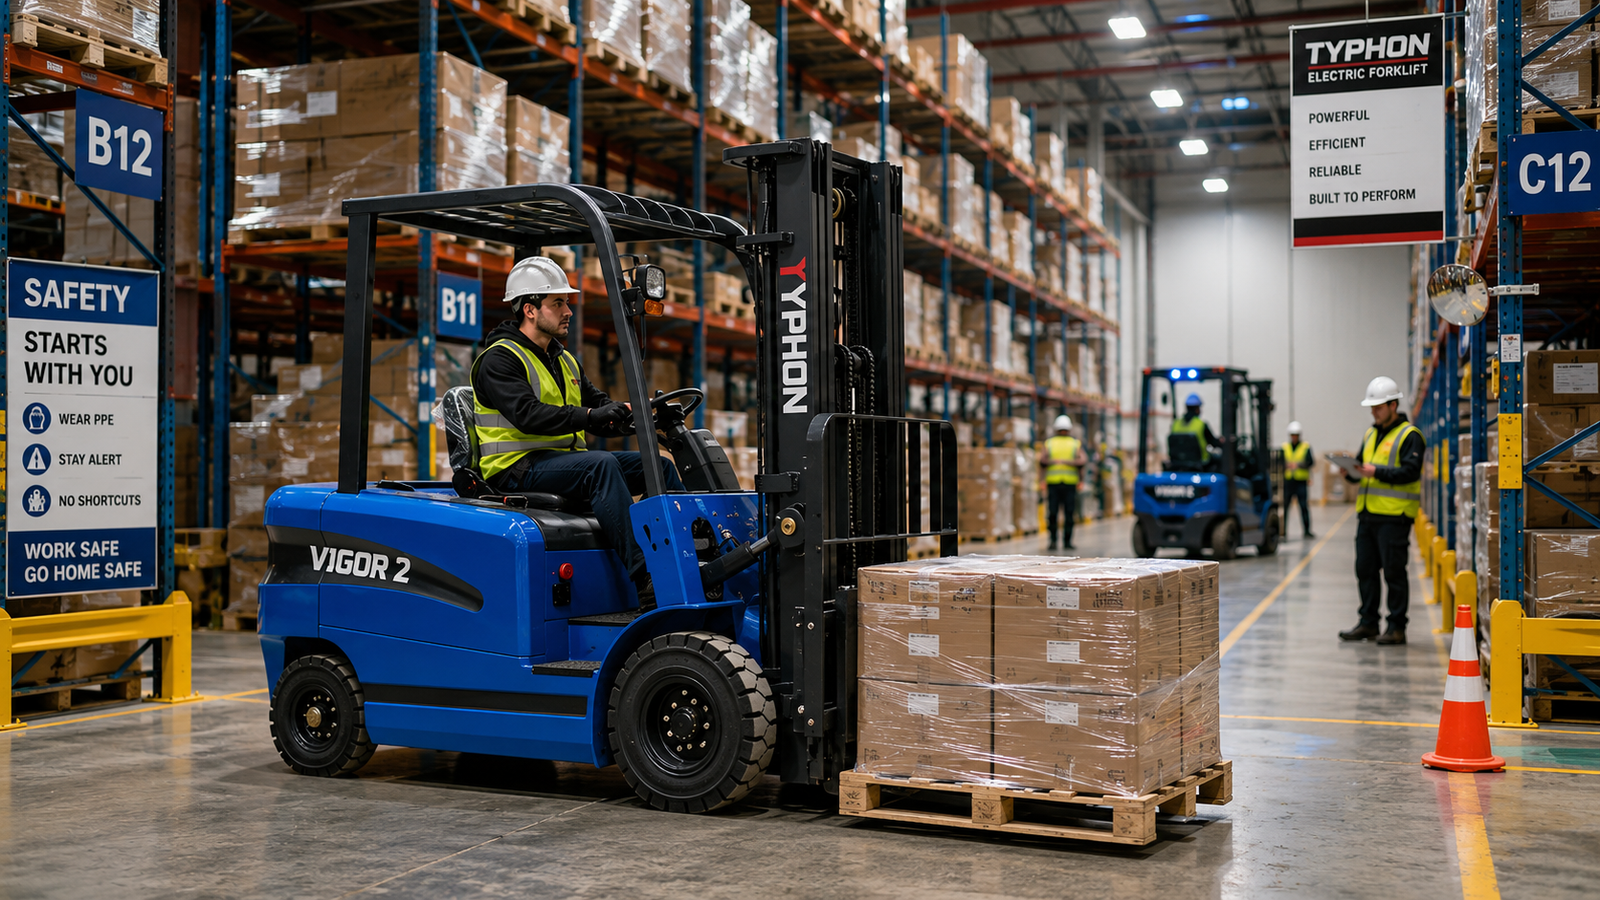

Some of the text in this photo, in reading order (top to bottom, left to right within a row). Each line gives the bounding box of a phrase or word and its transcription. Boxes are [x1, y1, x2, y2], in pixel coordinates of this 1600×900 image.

[1305, 32, 1431, 65] TYPHON
[1308, 63, 1428, 83] ELECTRIC FORKLIFT
[1308, 109, 1370, 124] POWERFUL
[88, 115, 152, 177] B12
[1309, 136, 1366, 151] EFFICIENT
[1309, 164, 1362, 178] RELIABLE
[1518, 150, 1592, 195] C12
[1309, 188, 1416, 205] BUILT TO PERFORM
[24, 277, 131, 313] SAFETY
[441, 287, 477, 326] B11
[24, 330, 108, 356] STARTS
[24, 361, 133, 387] WITH YOU
[59, 413, 114, 426] WEAR PPE
[58, 453, 122, 466] STAY ALERT
[58, 494, 141, 507] NO SHORTCUTS
[24, 540, 120, 560] WORK SAFE
[24, 561, 142, 583] GO HOME SAFE
[310, 545, 411, 584] VIGOR 2
